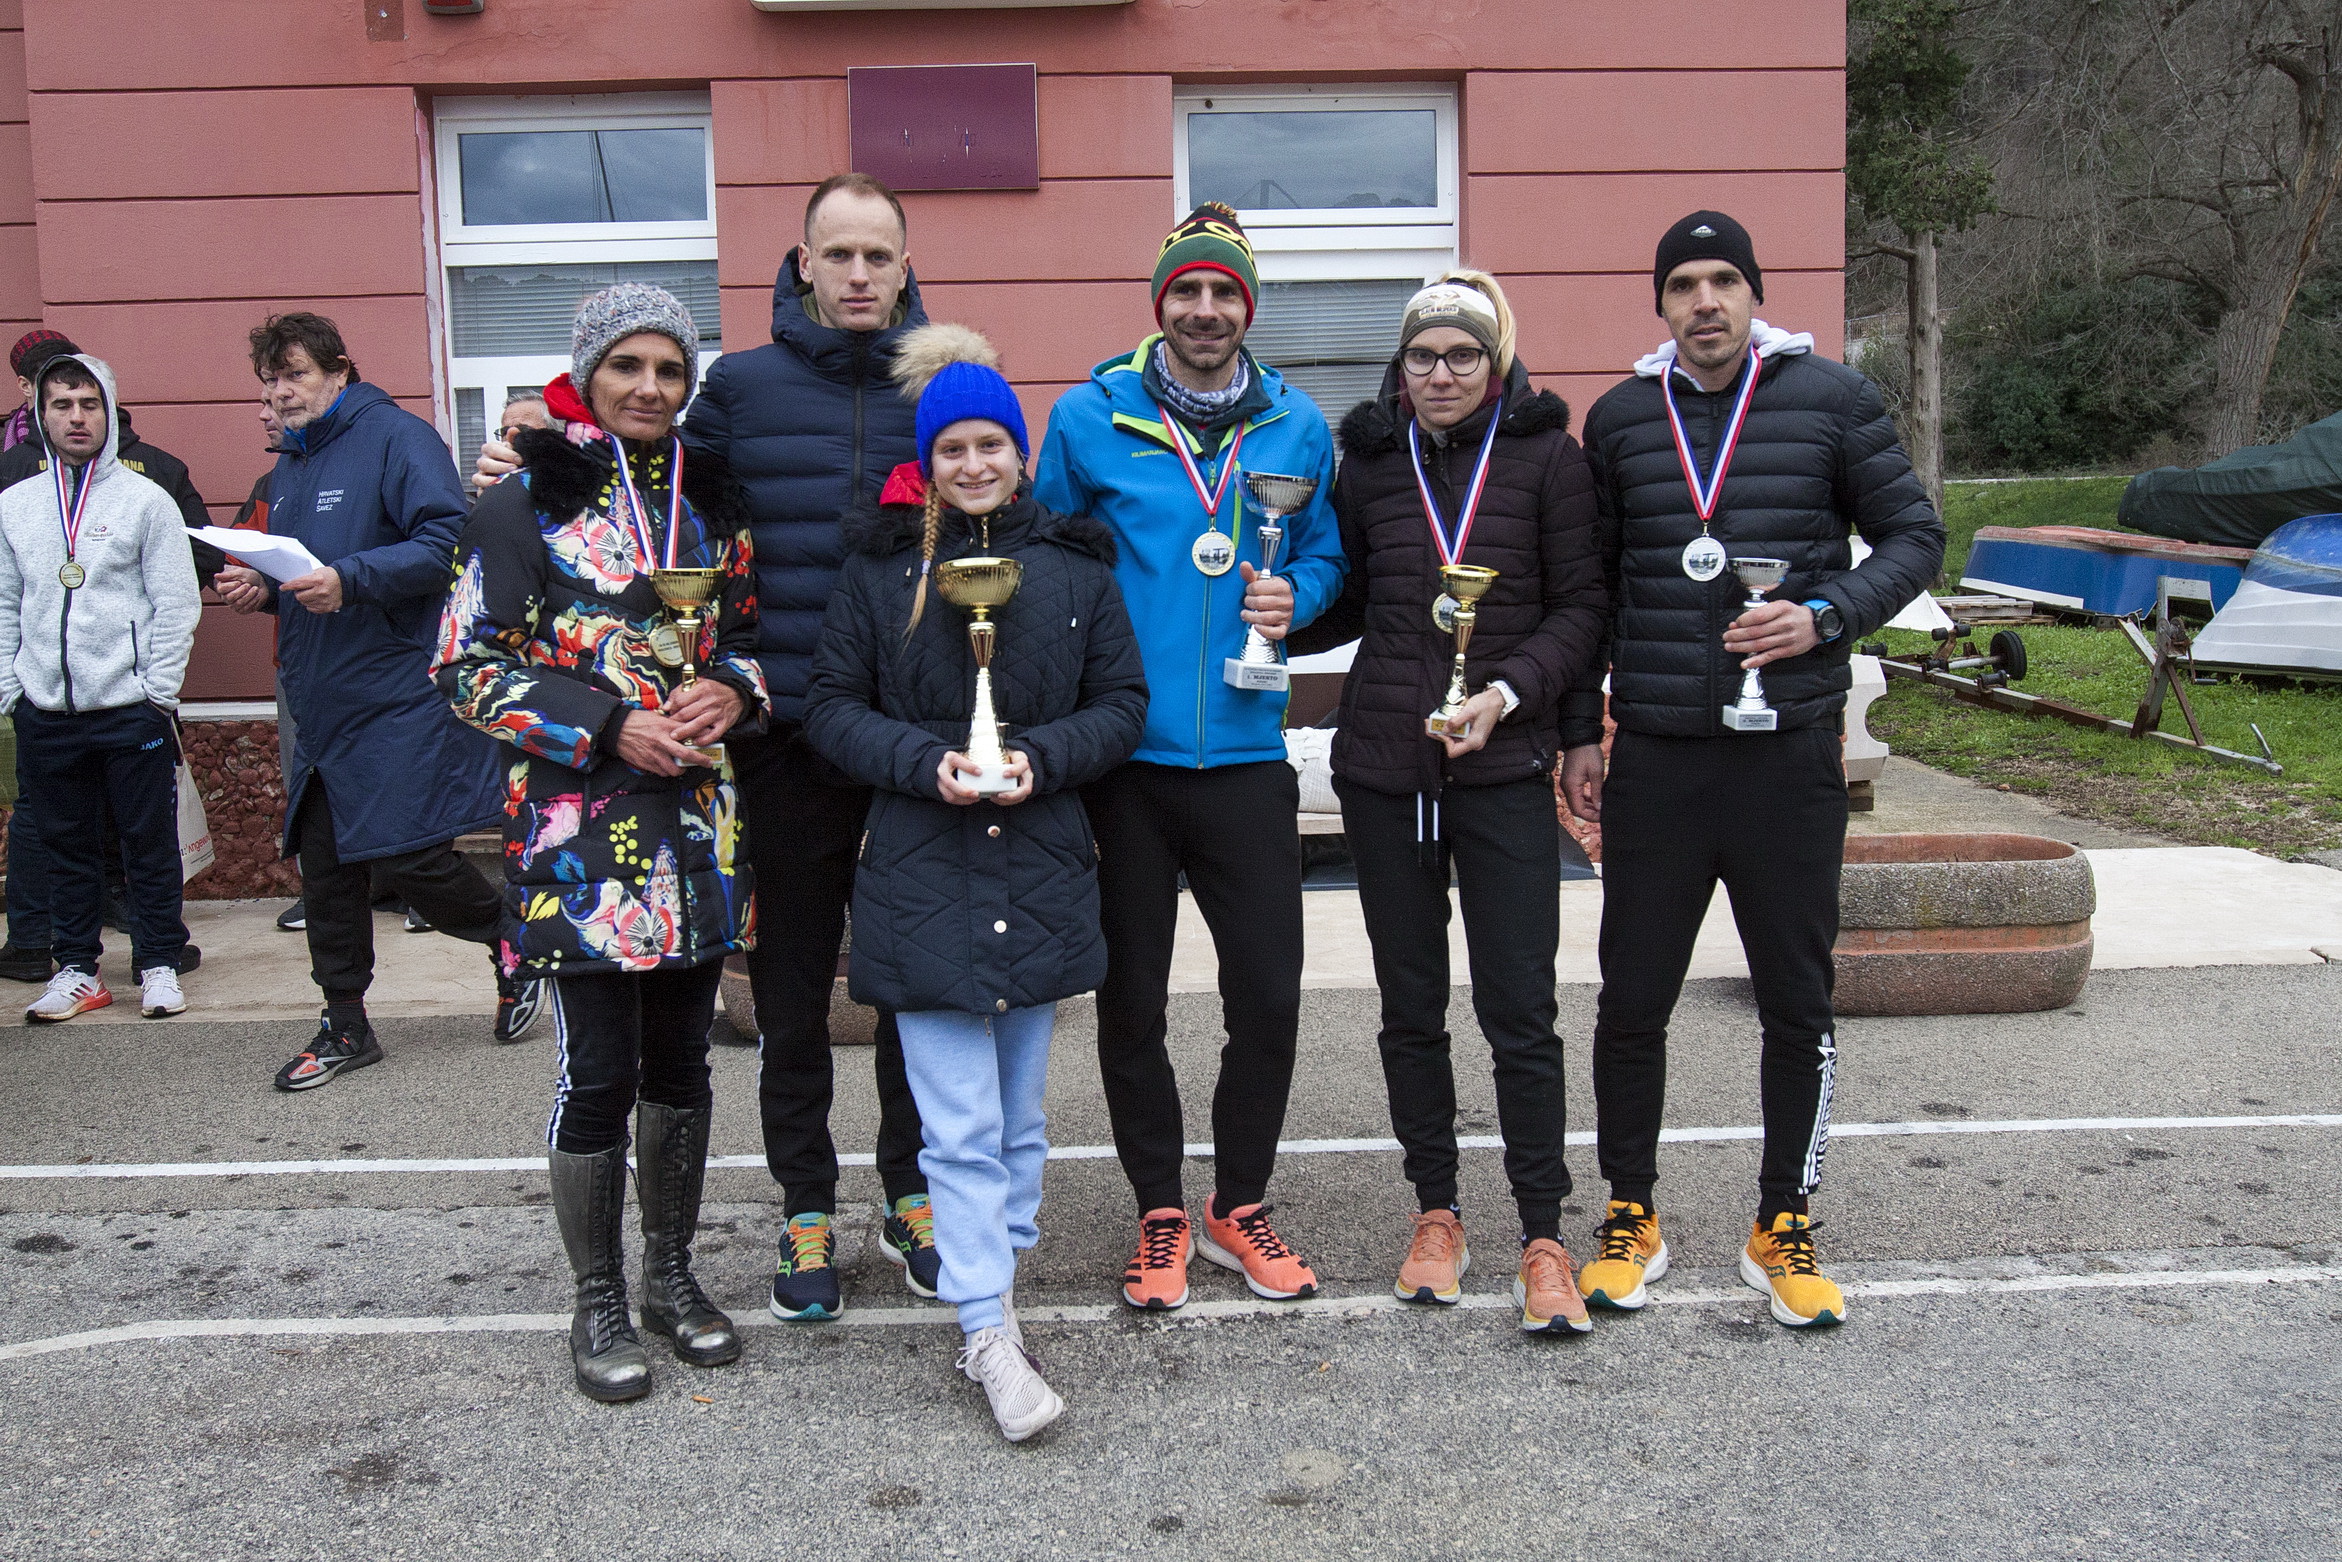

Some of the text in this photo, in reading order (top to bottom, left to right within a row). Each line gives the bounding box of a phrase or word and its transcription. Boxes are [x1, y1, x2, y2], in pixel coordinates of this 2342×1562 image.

[319, 489, 344, 497] HRVATSKI
[317, 496, 342, 504] ATLETSKI
[141, 737, 164, 750] JAKO
